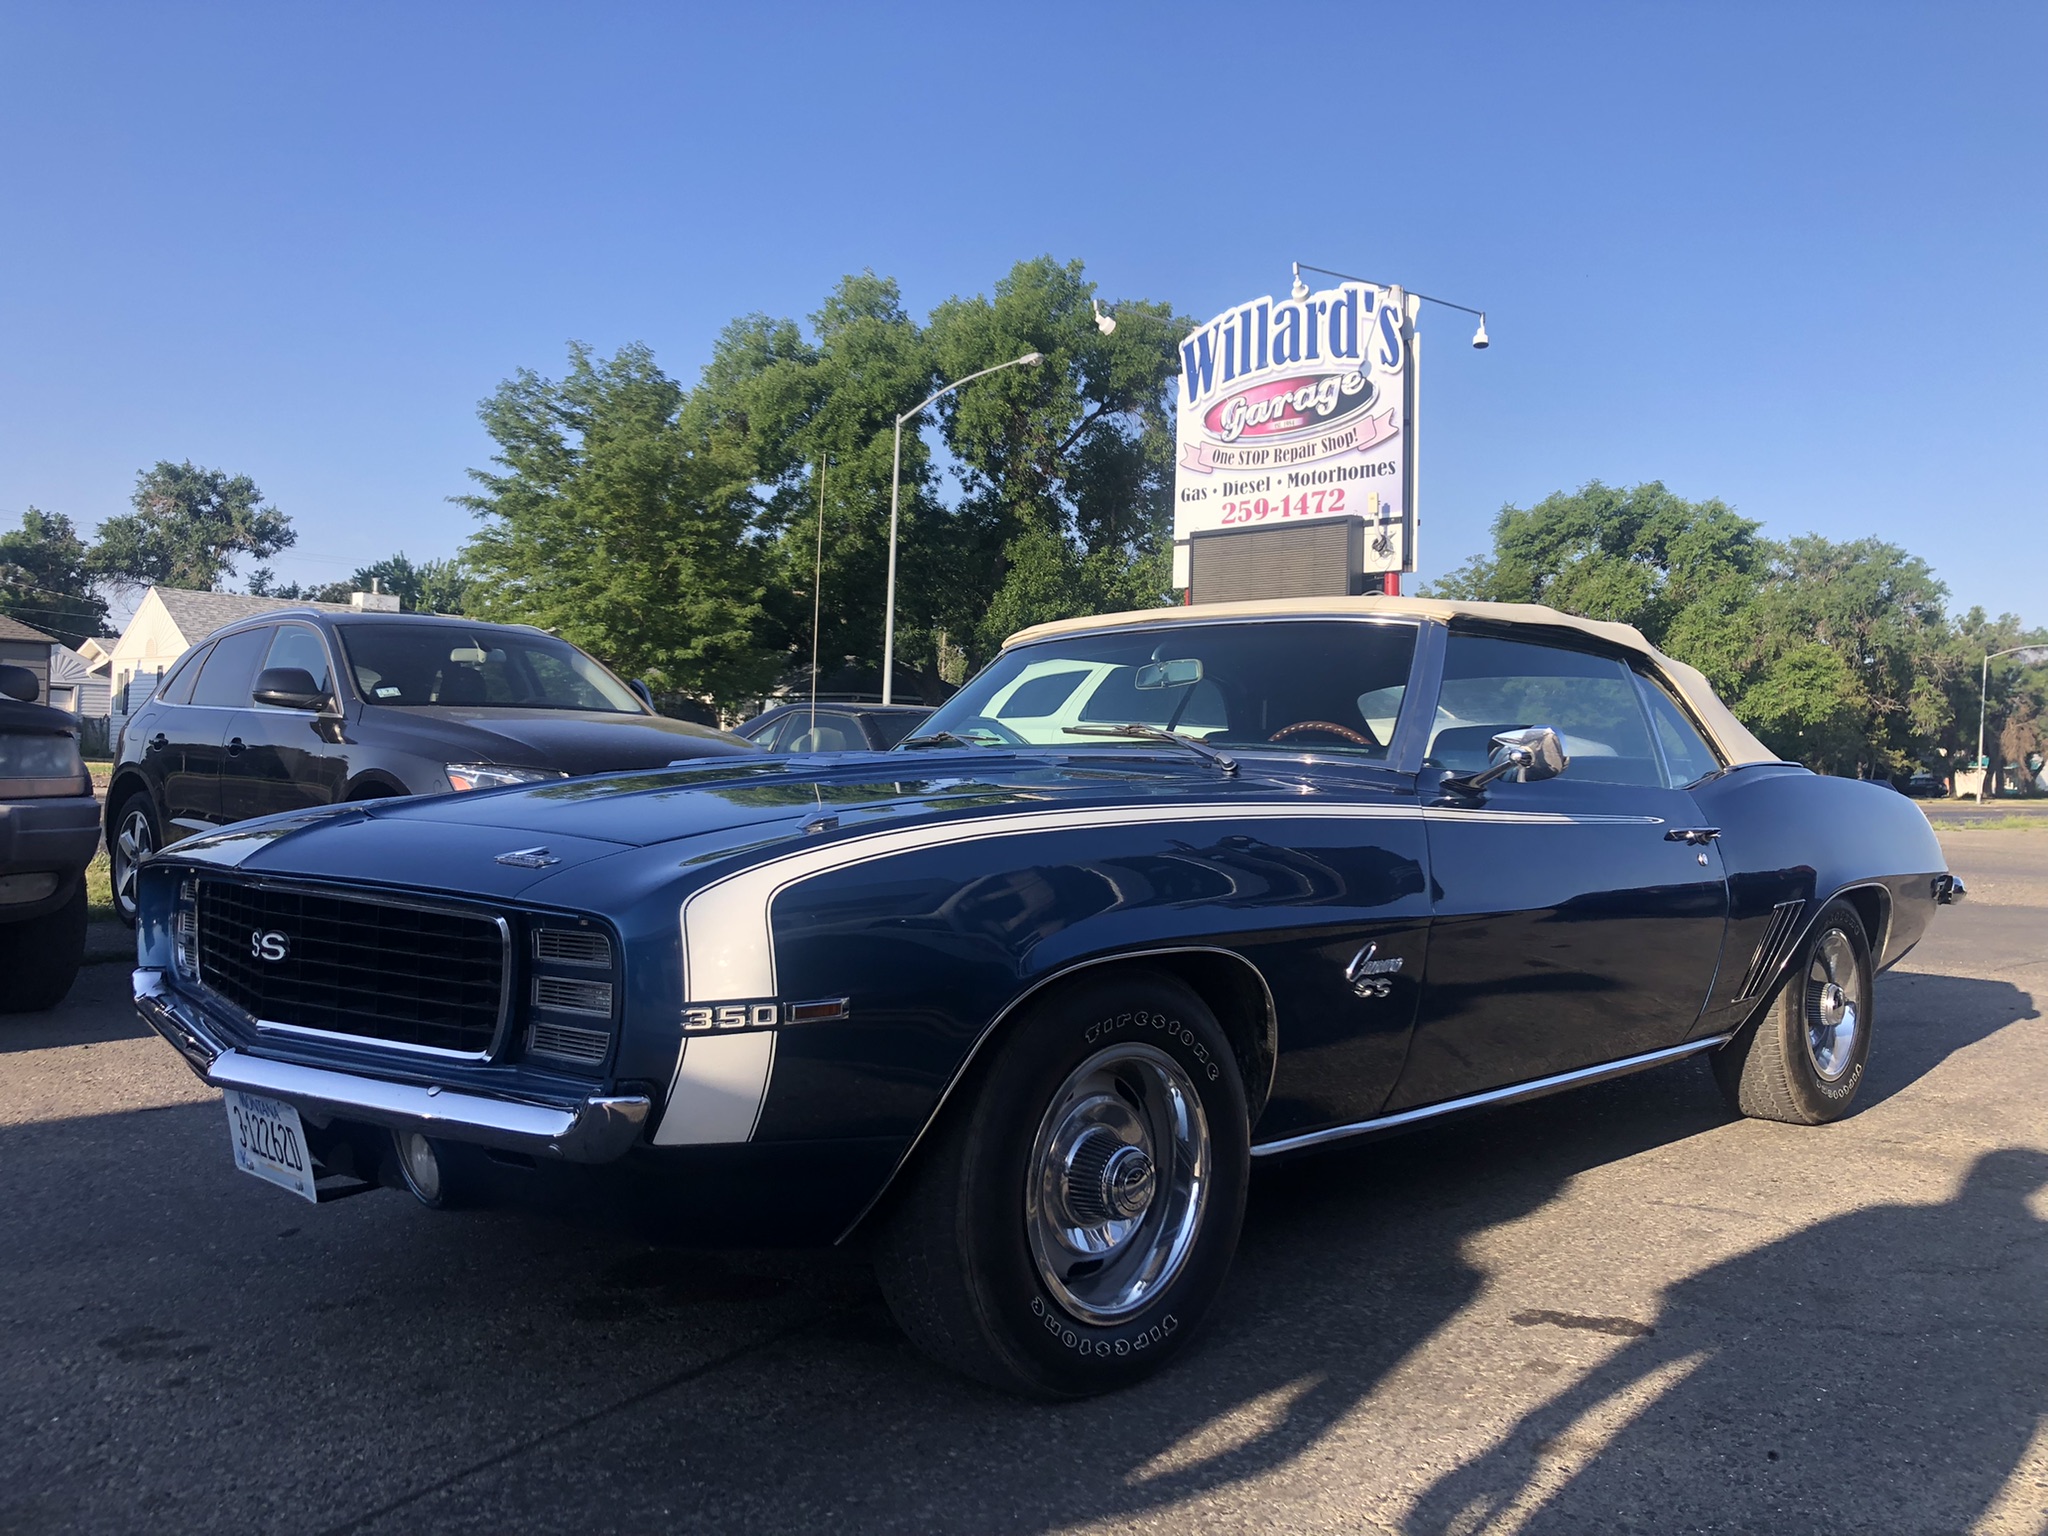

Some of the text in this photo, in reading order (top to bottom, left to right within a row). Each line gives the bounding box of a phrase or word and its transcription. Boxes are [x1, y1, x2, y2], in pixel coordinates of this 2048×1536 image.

[1181, 288, 1401, 404] Willard's
[1220, 370, 1366, 442] Garage
[1212, 427, 1358, 465] One STOP Repair Shop!
[1181, 460, 1396, 503] Gas Diesel Motorhomes
[1221, 488, 1345, 524] 259-1472
[251, 930, 288, 961] SS
[680, 1002, 778, 1031] 350
[1084, 1010, 1220, 1082] Firestone
